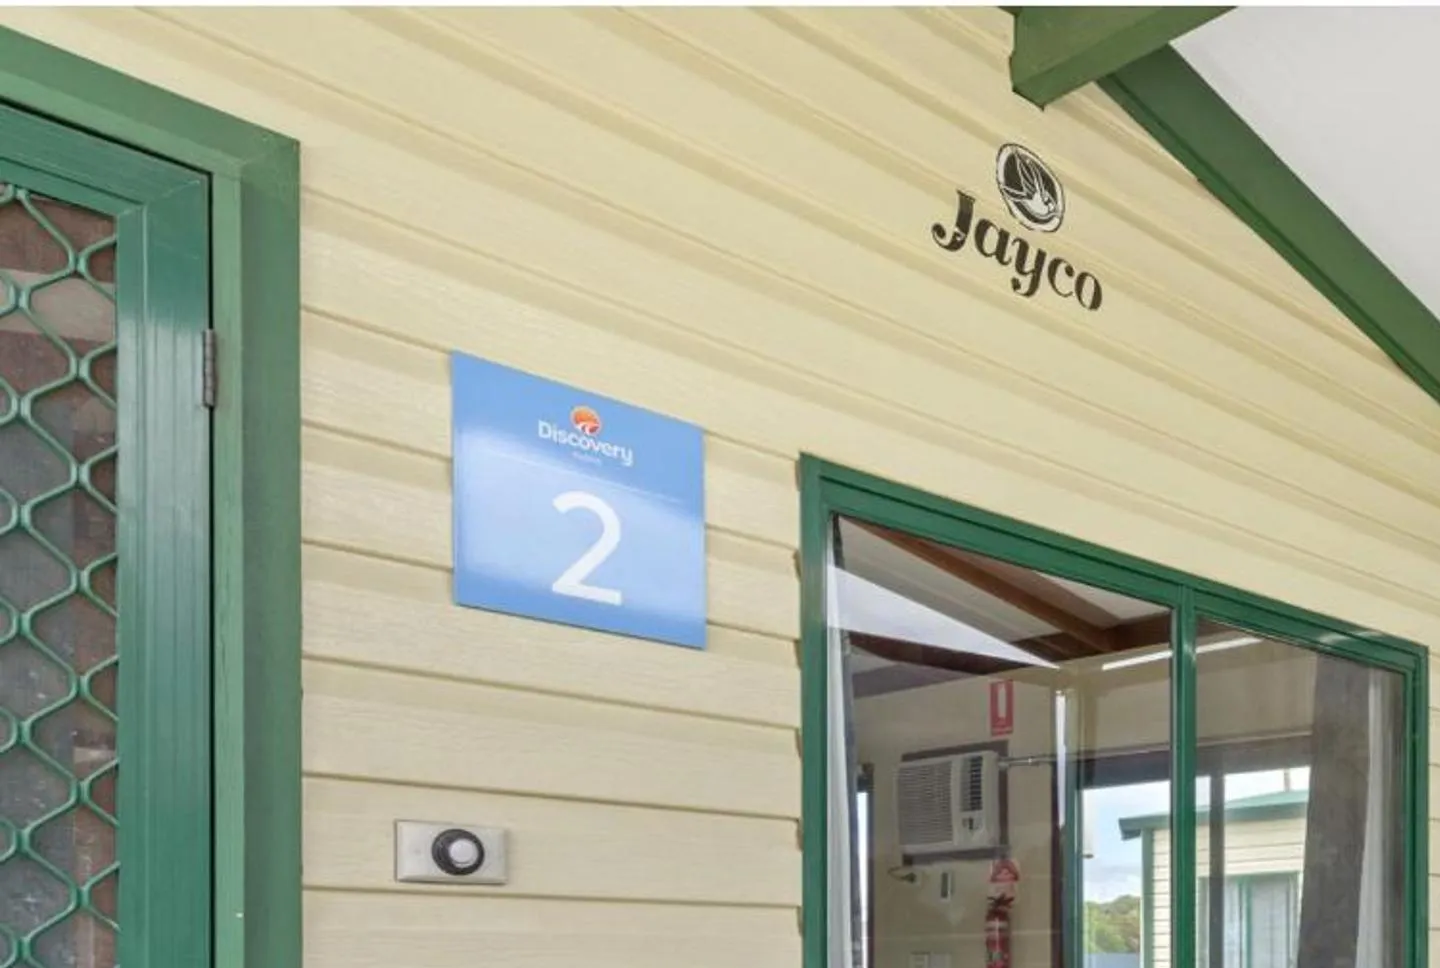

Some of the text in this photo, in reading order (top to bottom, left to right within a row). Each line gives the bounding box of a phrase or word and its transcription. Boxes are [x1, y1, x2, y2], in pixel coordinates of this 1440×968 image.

[931, 188, 1103, 311] Jayco
[538, 419, 634, 467] Discovery
[552, 489, 622, 606] 2
